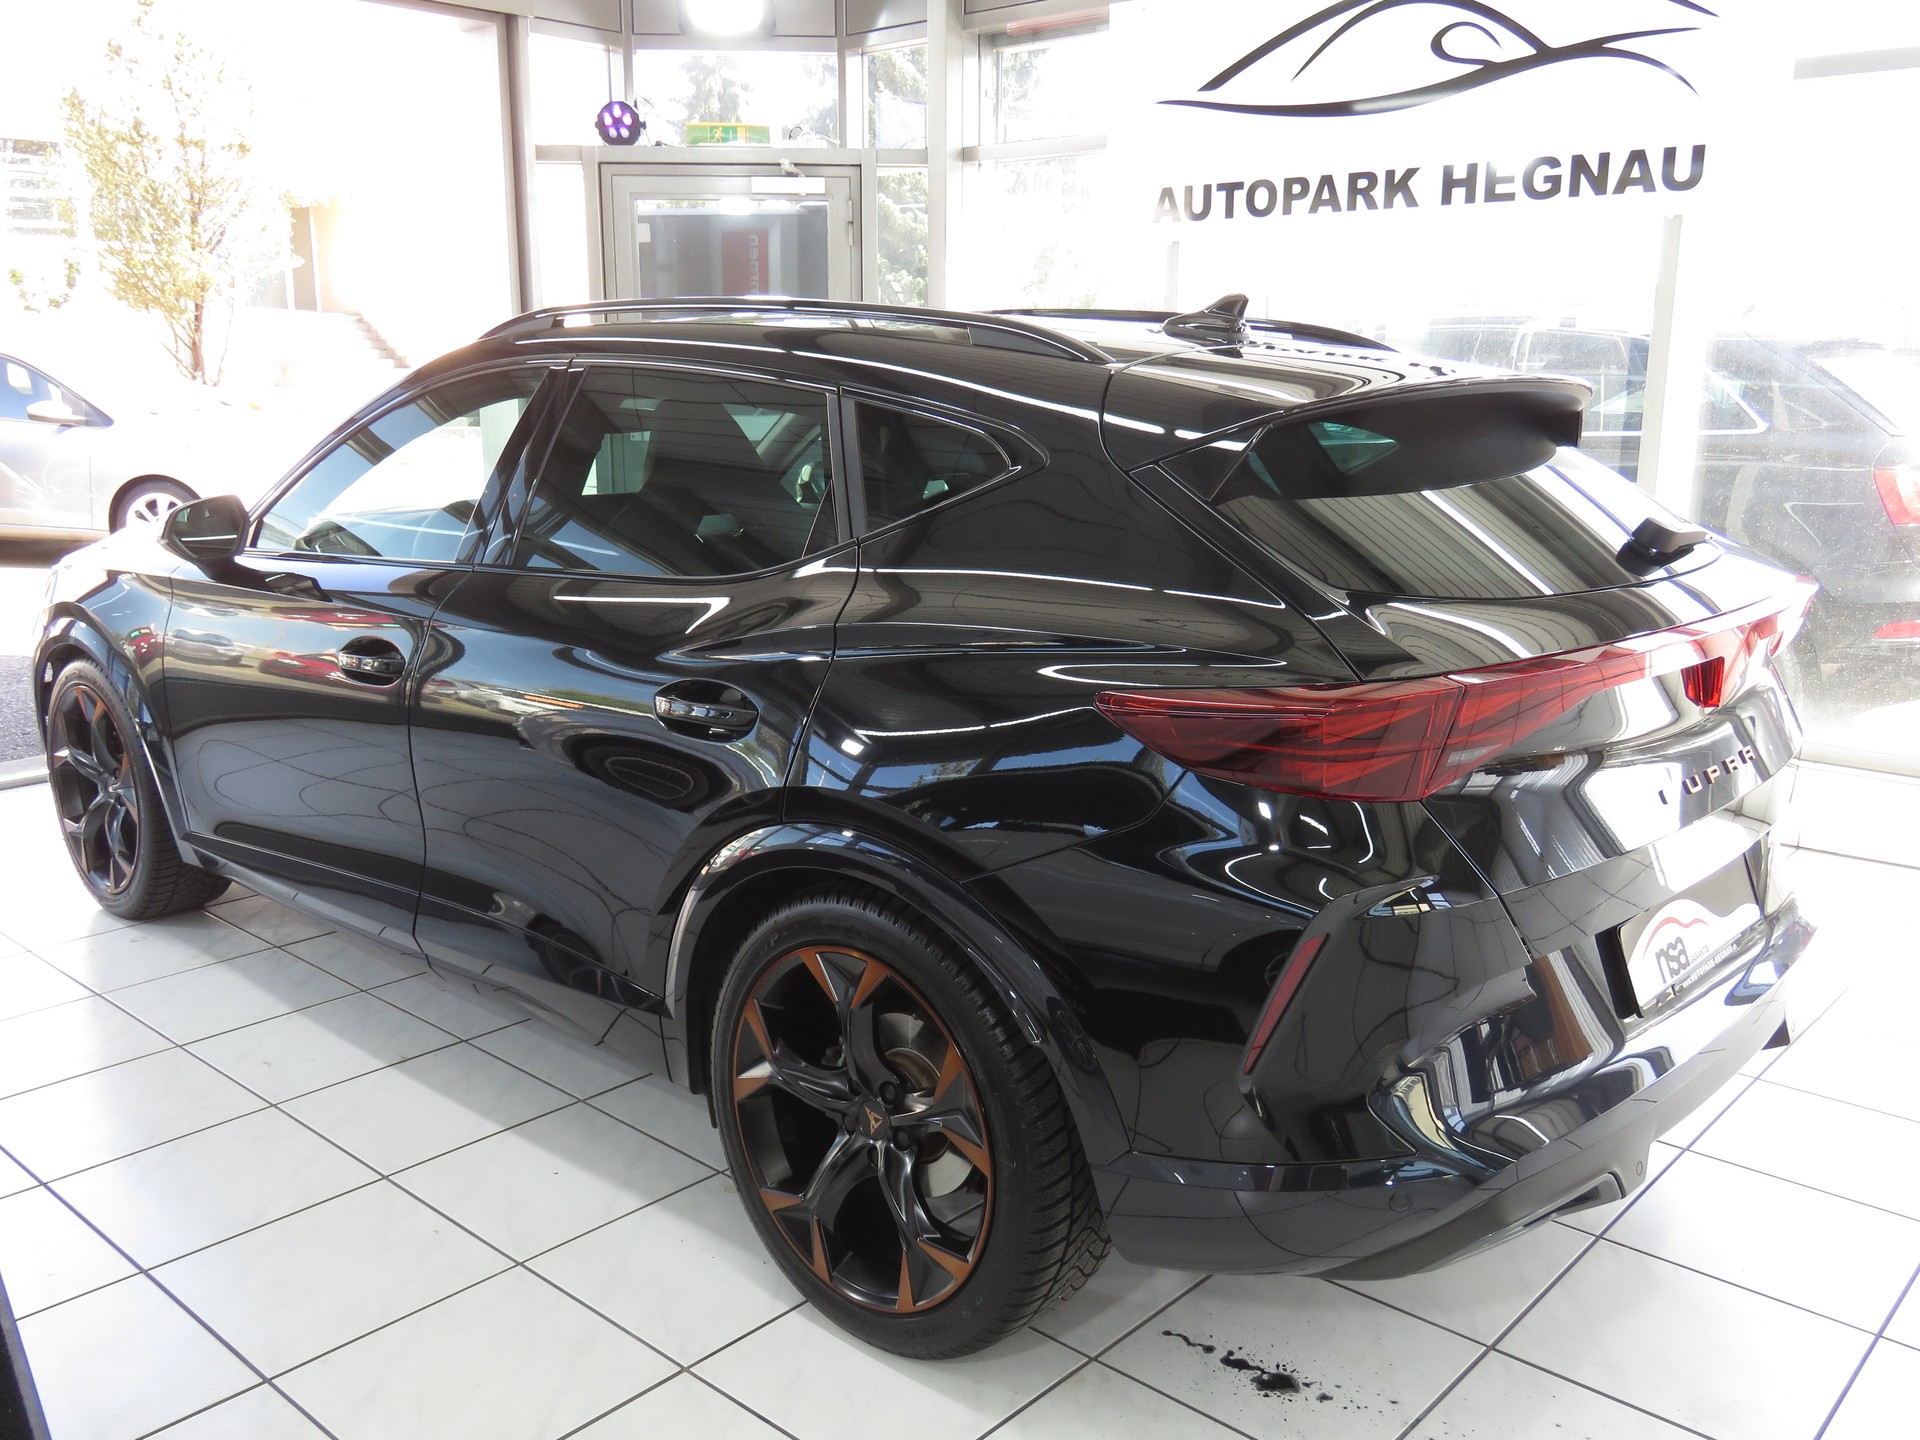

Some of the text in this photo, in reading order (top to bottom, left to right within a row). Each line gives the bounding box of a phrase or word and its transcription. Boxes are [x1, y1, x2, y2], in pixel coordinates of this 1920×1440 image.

[1152, 144, 1707, 224] AUTOPARK HEGNAU
[1655, 936, 1691, 984] nsa
